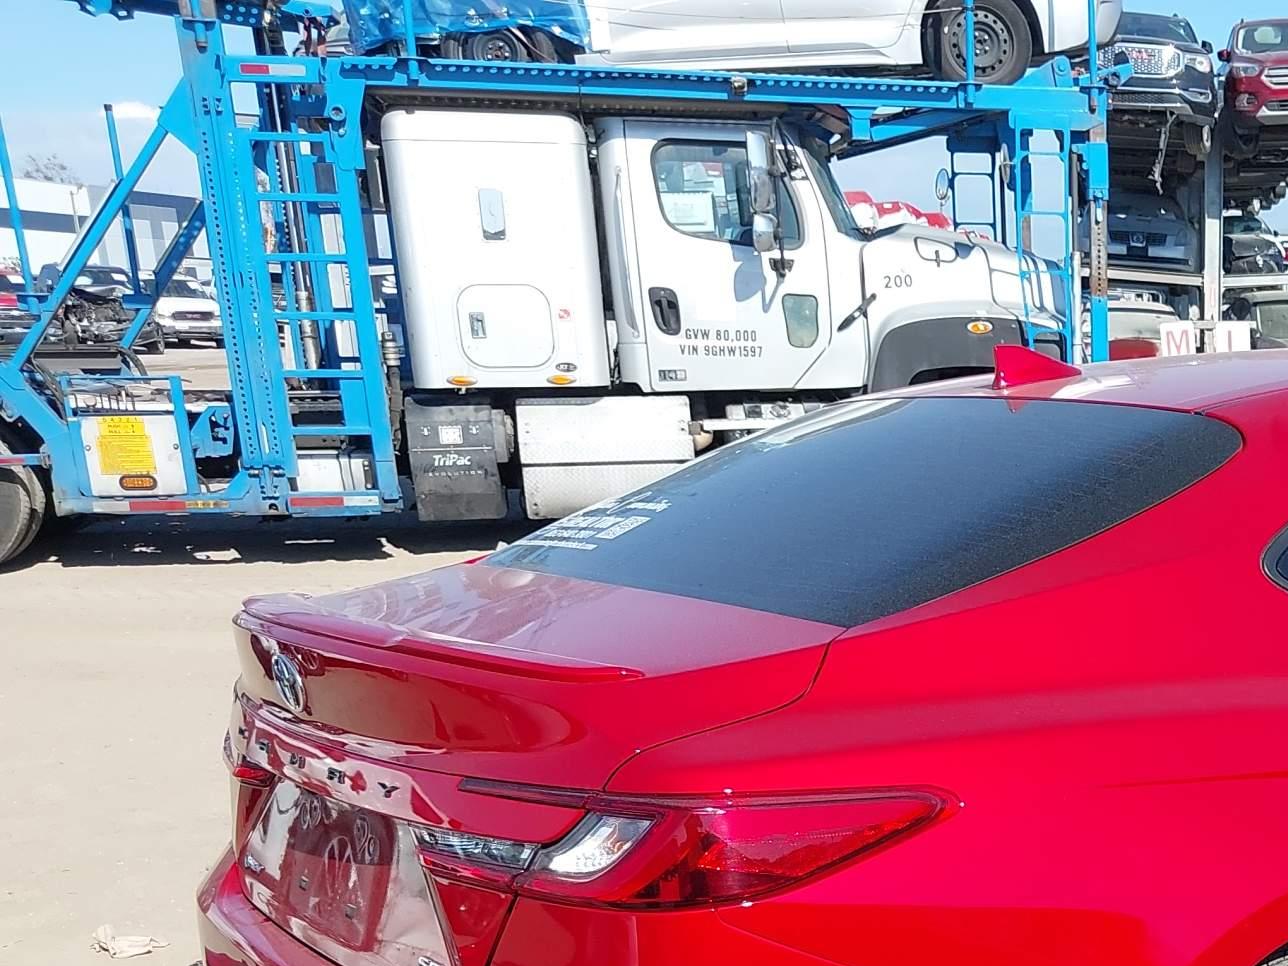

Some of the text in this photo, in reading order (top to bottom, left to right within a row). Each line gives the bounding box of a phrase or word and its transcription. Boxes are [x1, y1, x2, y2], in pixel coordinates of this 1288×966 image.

[883, 274, 913, 289] 200
[685, 328, 757, 343] GVW 80,000
[1165, 328, 1192, 355] M
[679, 344, 699, 356] VIN
[432, 453, 472, 467] TriPac
